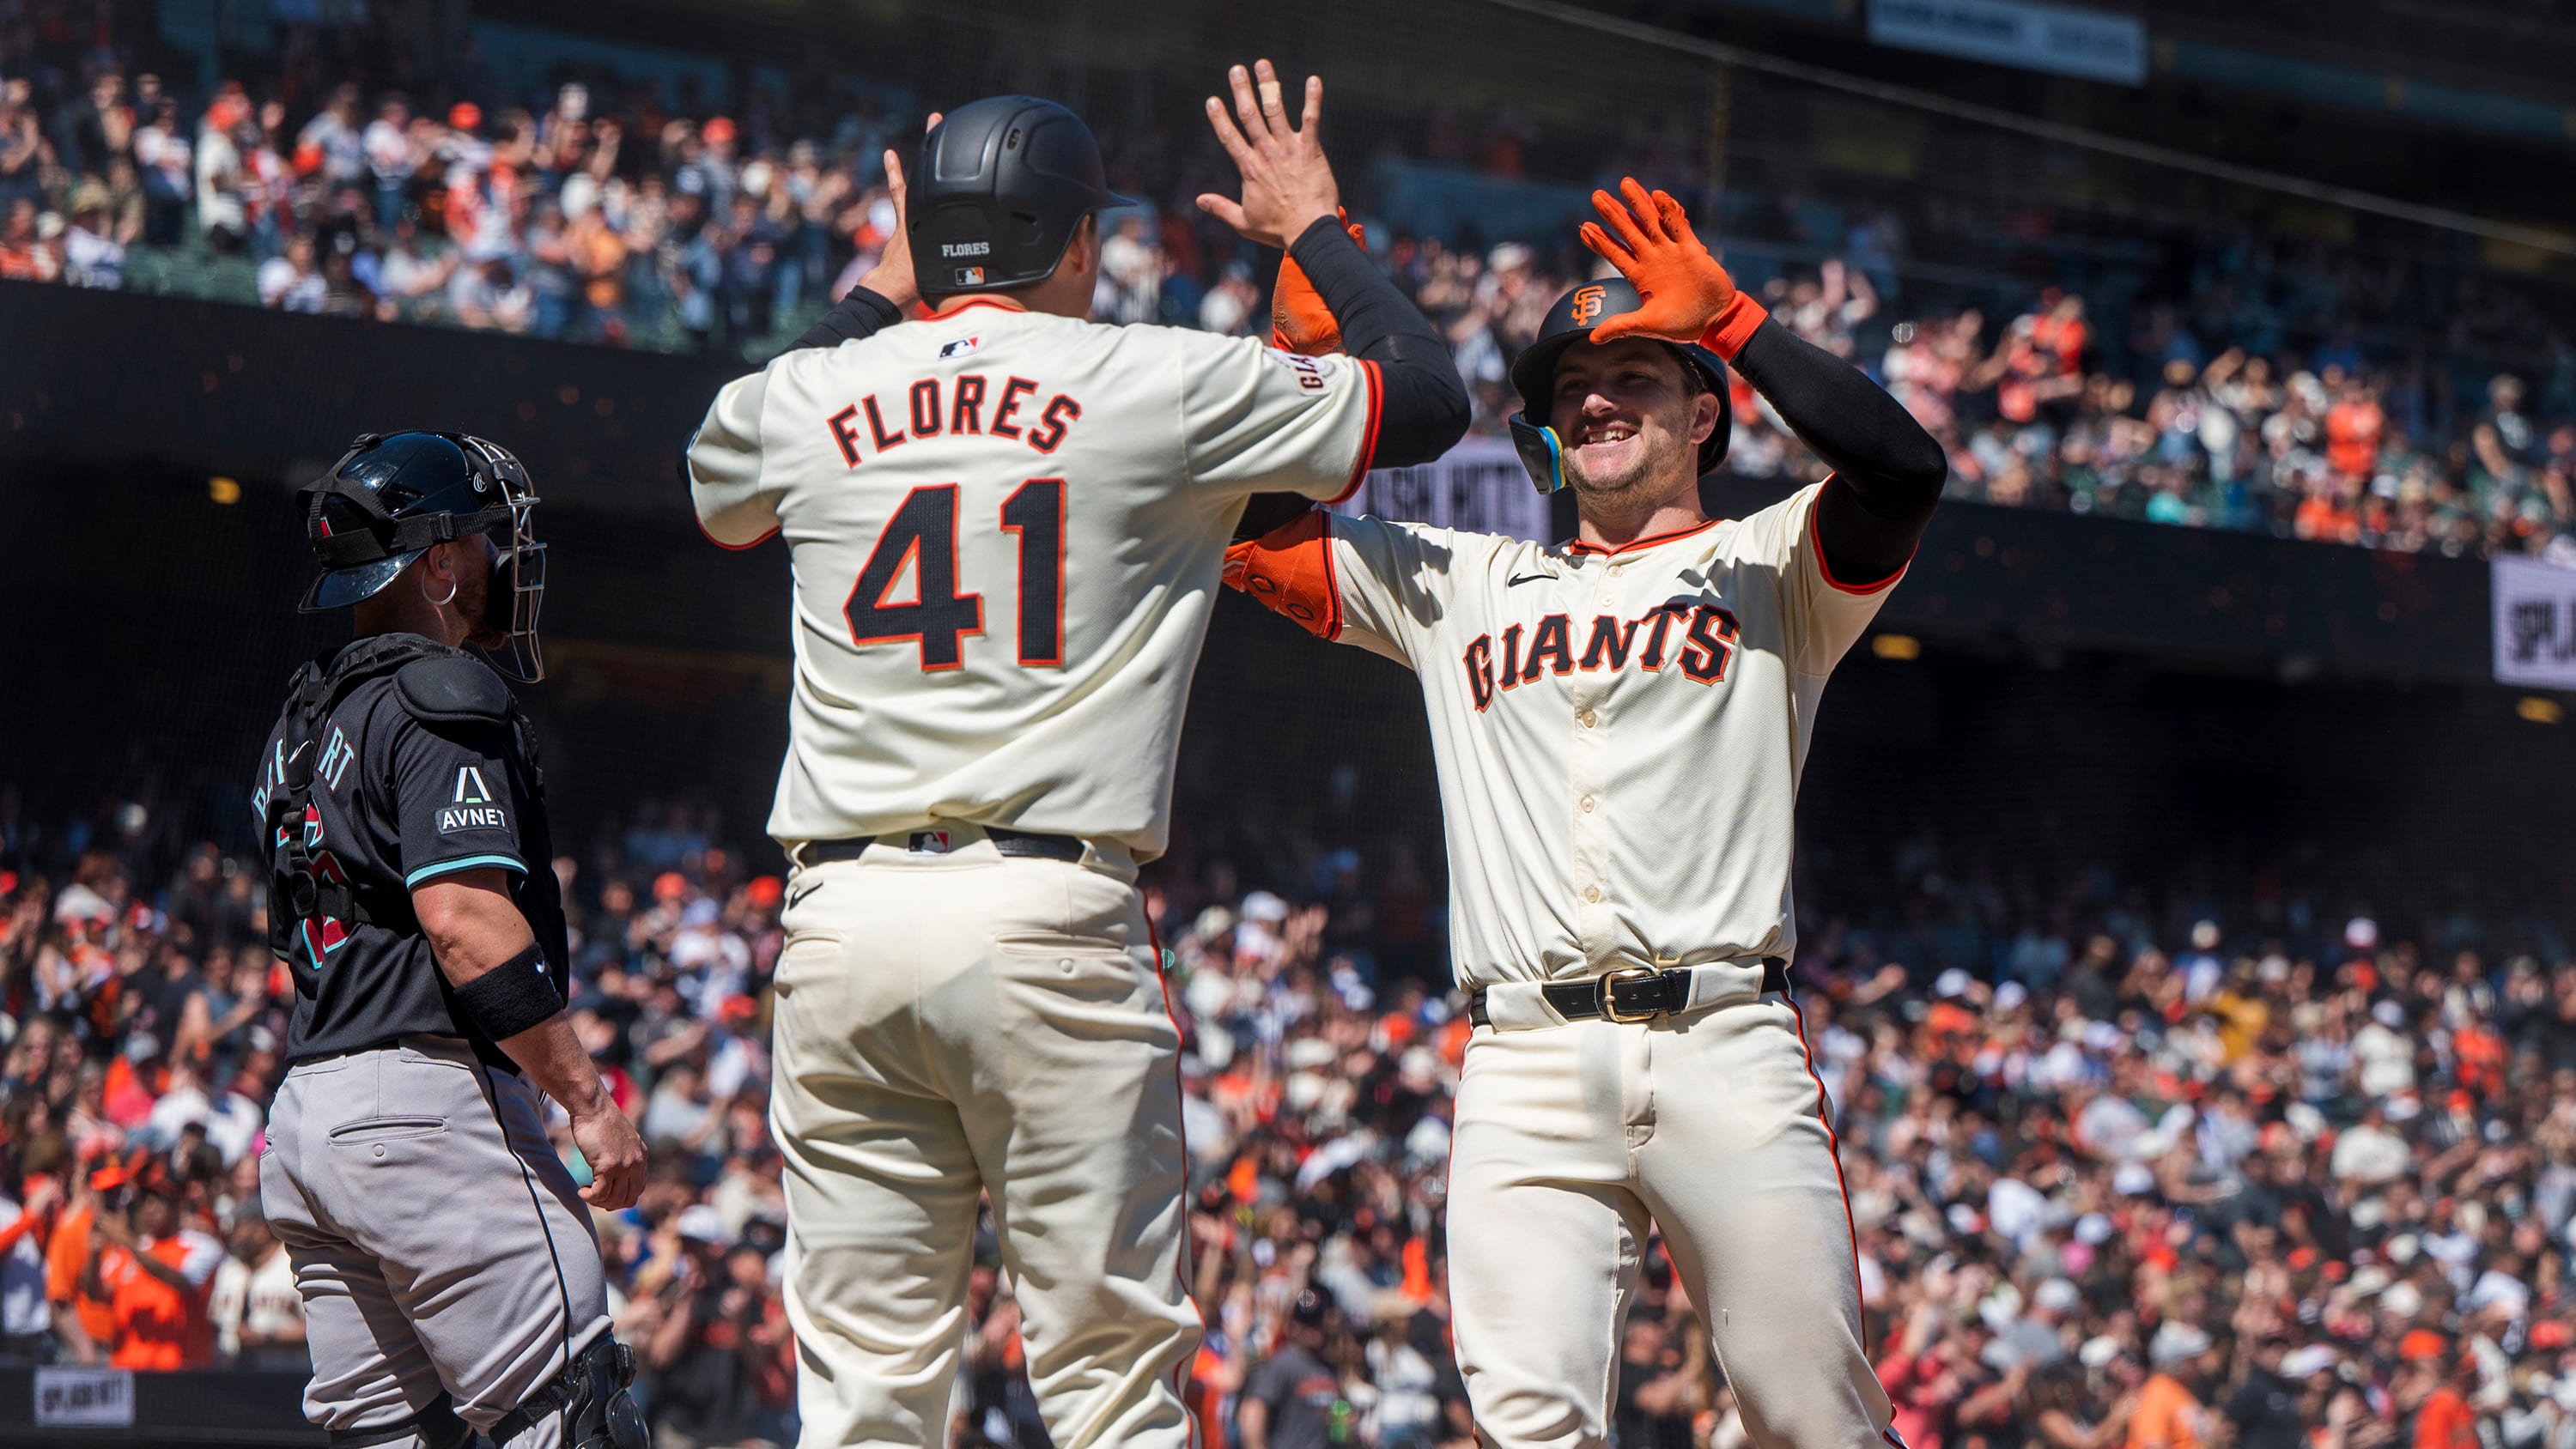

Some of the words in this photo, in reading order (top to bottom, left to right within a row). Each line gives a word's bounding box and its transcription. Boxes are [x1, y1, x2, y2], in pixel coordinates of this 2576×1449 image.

[941, 241, 990, 257] FLORES
[827, 374, 1082, 470] FLORES
[842, 477, 1068, 673] 41
[1463, 603, 1741, 714] GIANTS
[442, 808, 506, 830] AVNET
